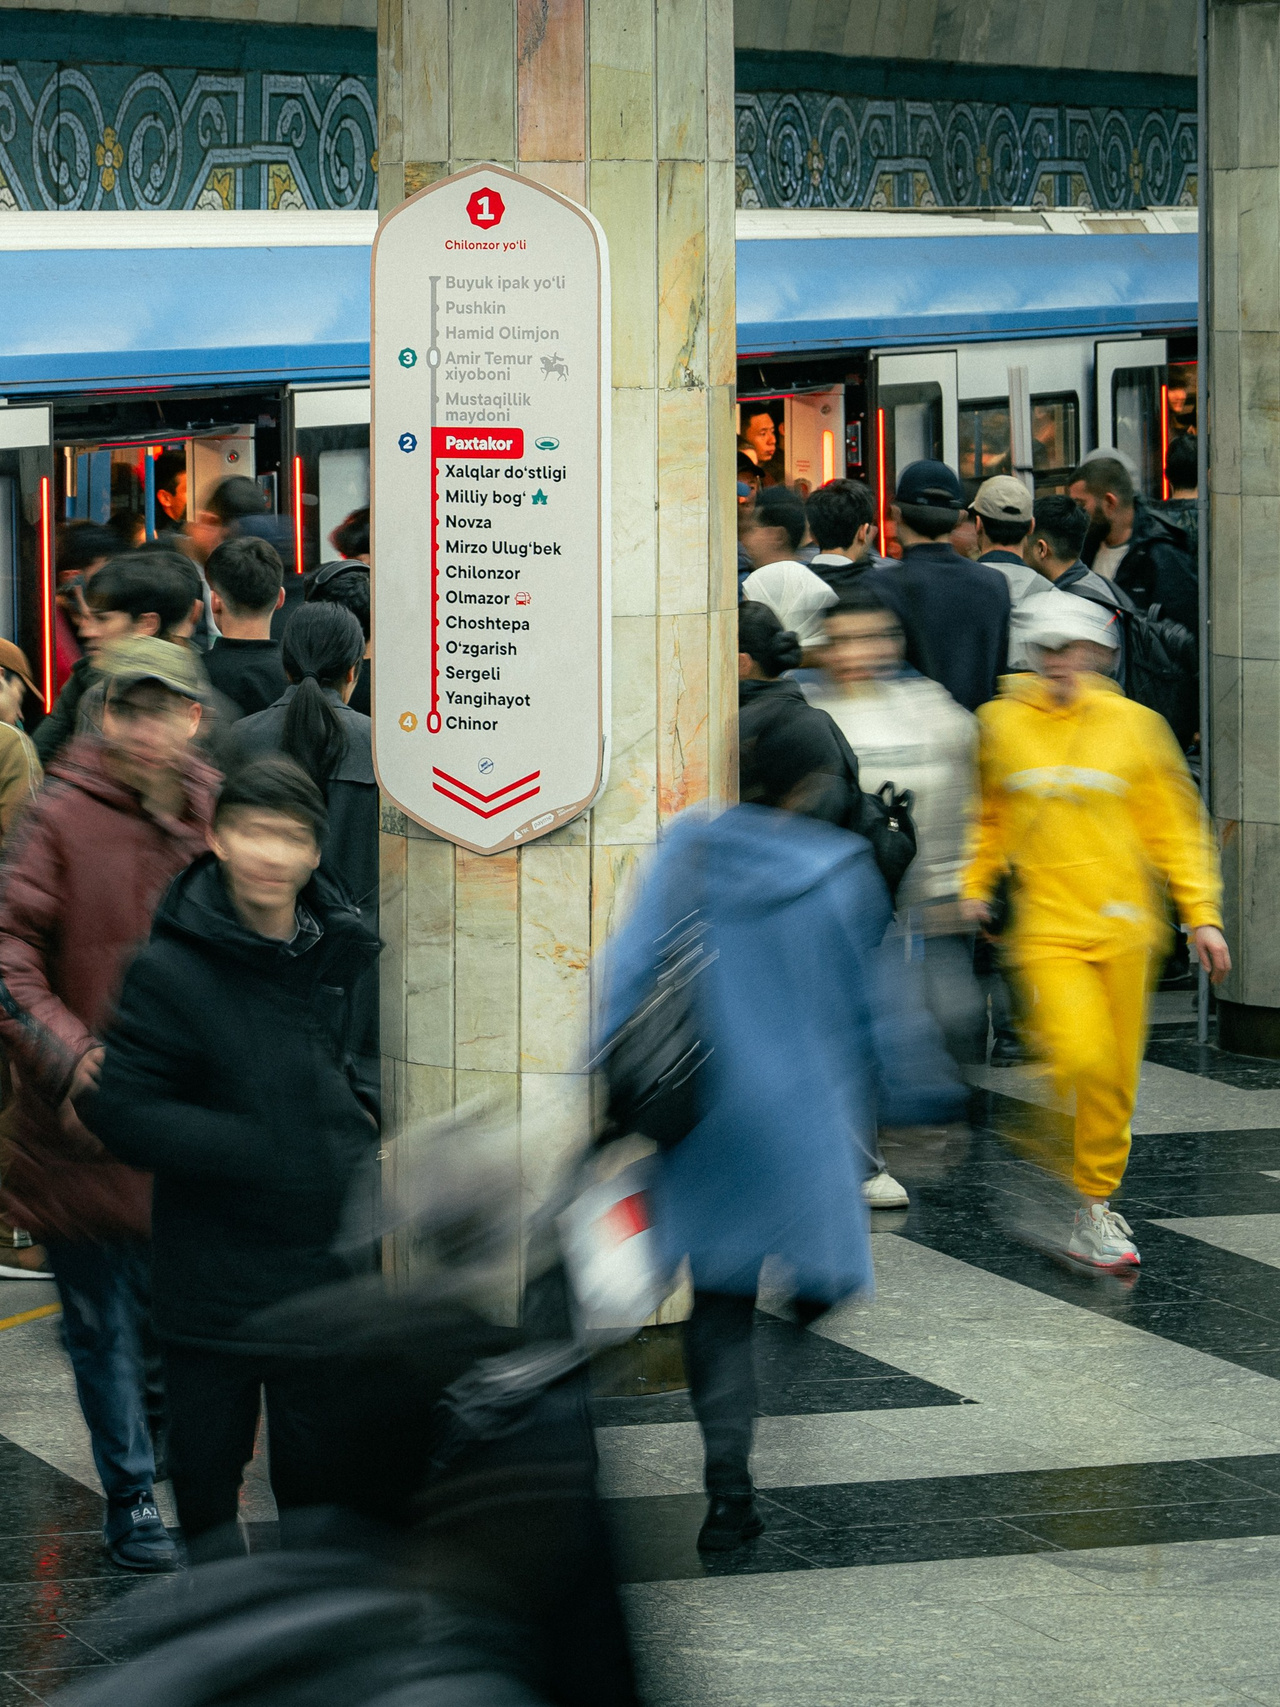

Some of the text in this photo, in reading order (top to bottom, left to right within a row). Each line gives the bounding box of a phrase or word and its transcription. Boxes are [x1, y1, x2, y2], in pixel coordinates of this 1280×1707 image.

[477, 196, 495, 221] 1
[444, 239, 501, 250] Chilonzor
[445, 276, 494, 293] Buyuk
[497, 276, 530, 293] ipak
[445, 300, 506, 315] Pushkin
[445, 325, 560, 343] Hamid Olimjon
[402, 351, 414, 365] 3
[445, 350, 533, 366] Amir Temur
[445, 366, 511, 383] xiyoboni
[445, 391, 532, 408] Mustaqillik
[445, 408, 510, 425] maydoni
[402, 436, 413, 449] 2
[445, 435, 514, 451] Paxtakor
[445, 464, 501, 482] Xalqlar
[445, 489, 489, 507] Milliy
[445, 514, 492, 529] Novza
[445, 539, 488, 554] Mirzo
[445, 564, 521, 580] Chilonzor
[445, 590, 511, 605] Olmazor
[445, 615, 530, 633] Choshtepa
[445, 665, 500, 683] Sergeli
[445, 690, 531, 709] Yangihayot
[402, 715, 413, 728] 4
[445, 715, 499, 731] Chinor
